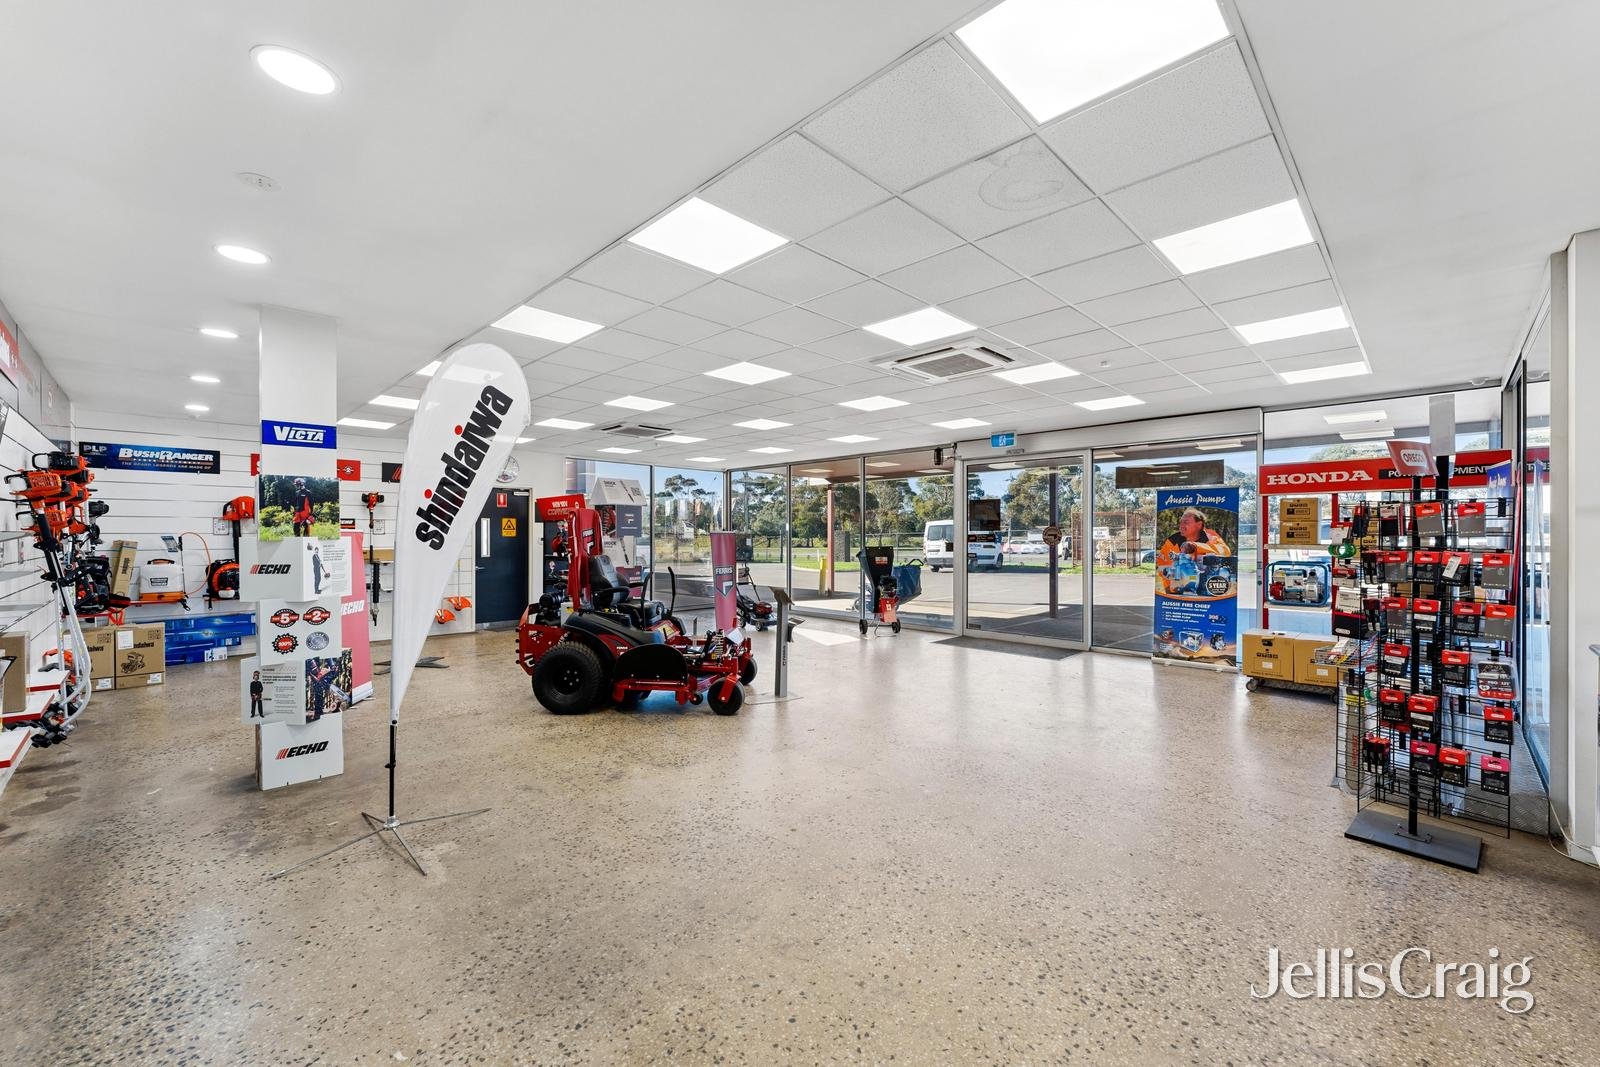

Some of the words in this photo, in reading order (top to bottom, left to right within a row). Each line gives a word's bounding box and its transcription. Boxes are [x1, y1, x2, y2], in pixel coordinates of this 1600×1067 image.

[273, 425, 326, 443] VICTA
[415, 385, 513, 551] shindaiwa
[1266, 470, 1373, 486] HONDA
[1165, 494, 1193, 506] Aussie
[1195, 493, 1226, 505] Pumps
[257, 564, 292, 575] ECHO
[280, 613, 290, 624] 5
[312, 610, 321, 621] 2
[286, 741, 329, 759] ECHO
